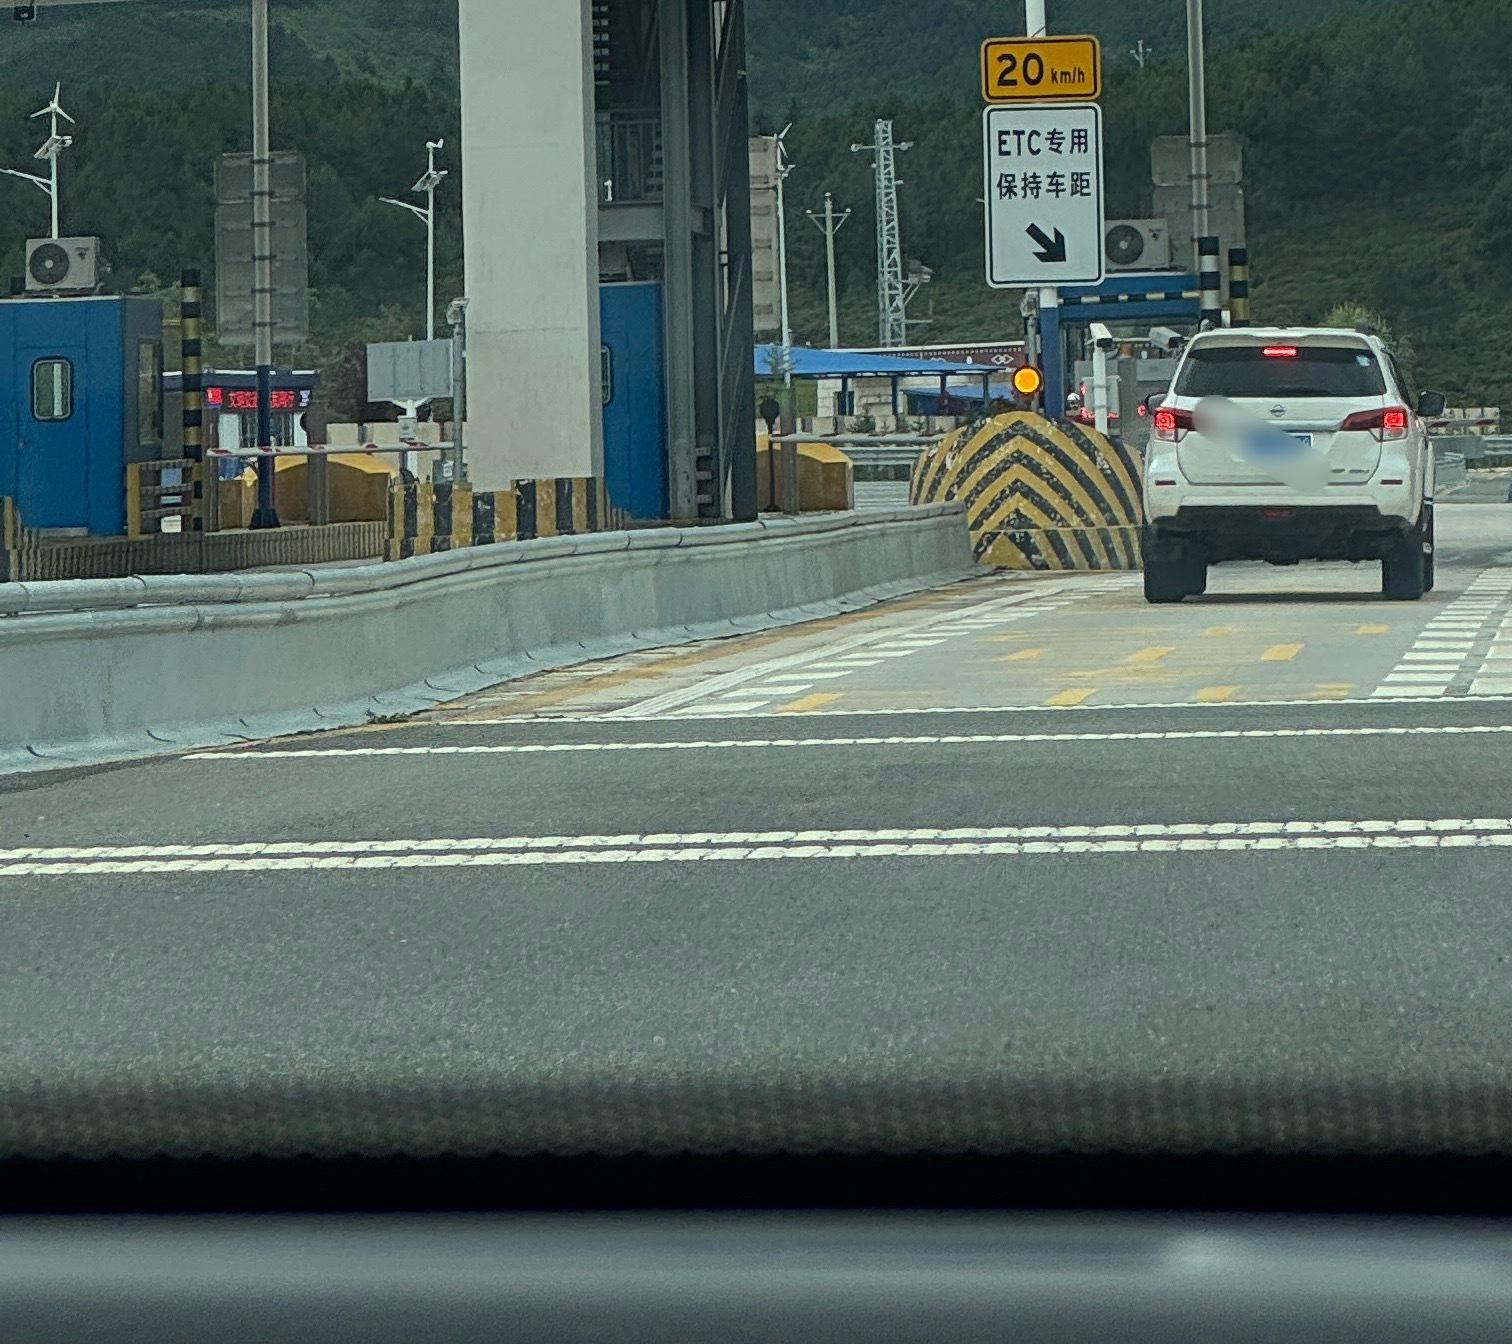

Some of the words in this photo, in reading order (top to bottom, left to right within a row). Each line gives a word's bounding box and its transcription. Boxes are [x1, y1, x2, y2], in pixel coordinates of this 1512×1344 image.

[996, 52, 1045, 87] 20
[1050, 66, 1086, 85] km/h
[997, 127, 1089, 157] ETC专用
[996, 170, 1092, 201] 保持车距
